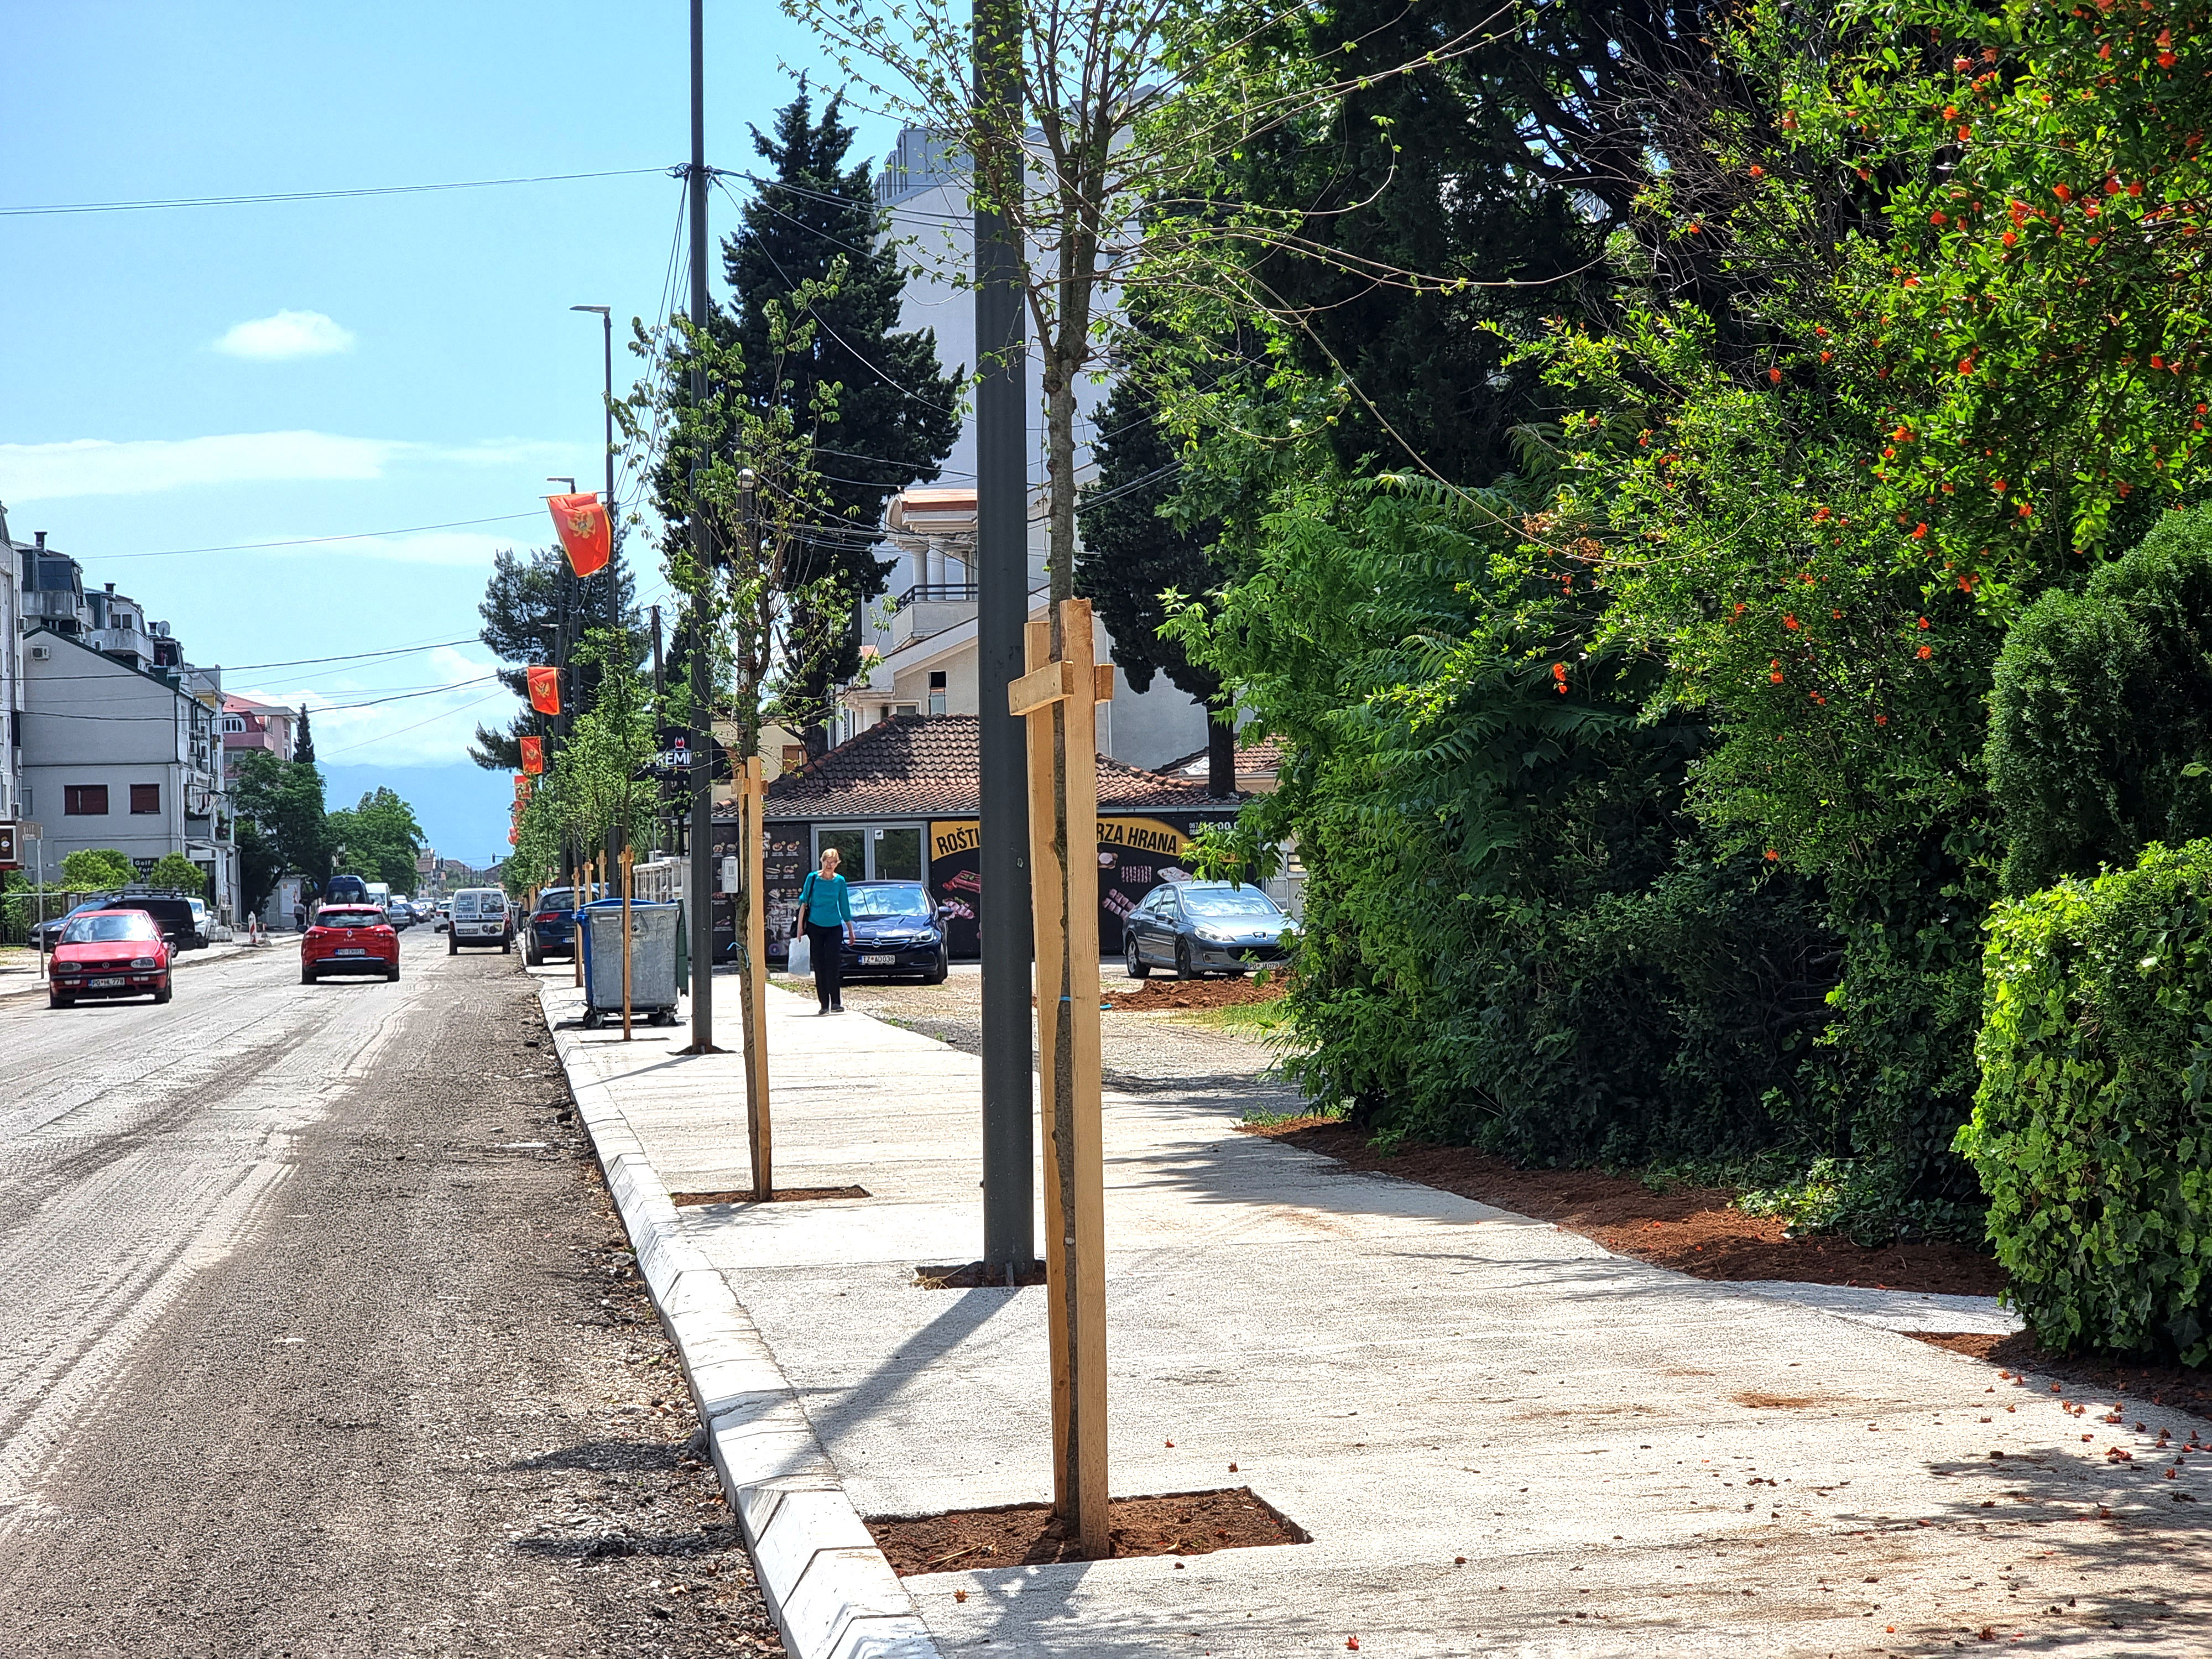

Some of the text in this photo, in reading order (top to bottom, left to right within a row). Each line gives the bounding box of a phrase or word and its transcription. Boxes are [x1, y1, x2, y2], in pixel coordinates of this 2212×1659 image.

[653, 753, 692, 766] REMI
[936, 822, 1177, 855] ROŠTI RZA HRANA
